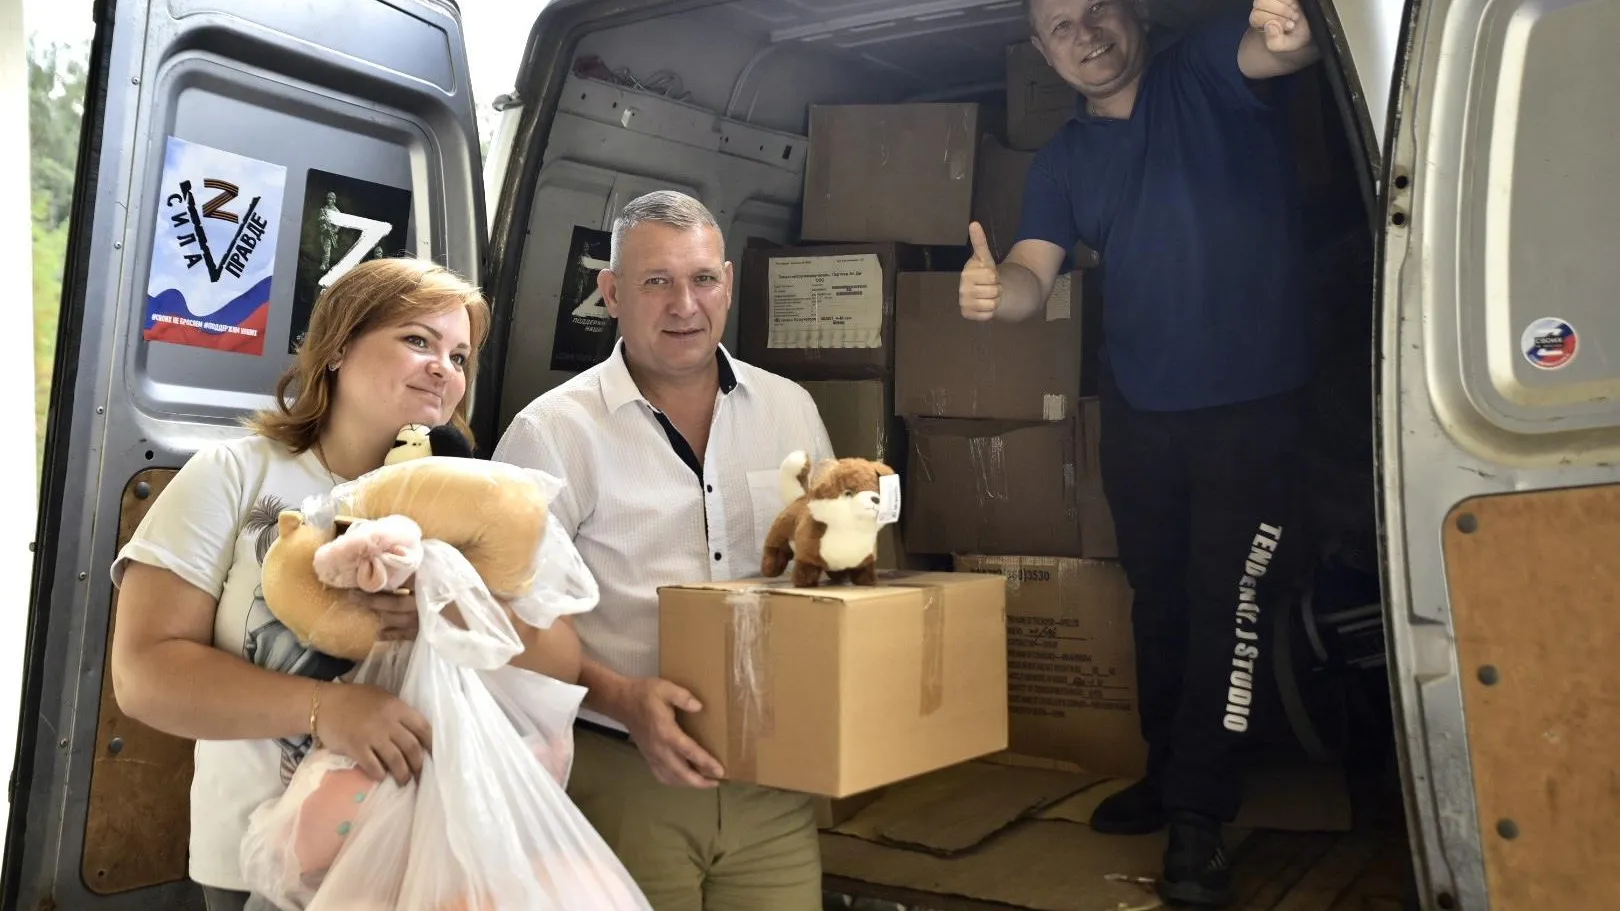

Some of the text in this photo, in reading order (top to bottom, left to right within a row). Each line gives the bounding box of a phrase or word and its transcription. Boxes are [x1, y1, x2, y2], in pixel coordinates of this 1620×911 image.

[167, 180, 268, 282] СИЛА V ПРАВДЕ
[202, 178, 239, 224] Z
[1223, 642, 1259, 732] STUDIO
